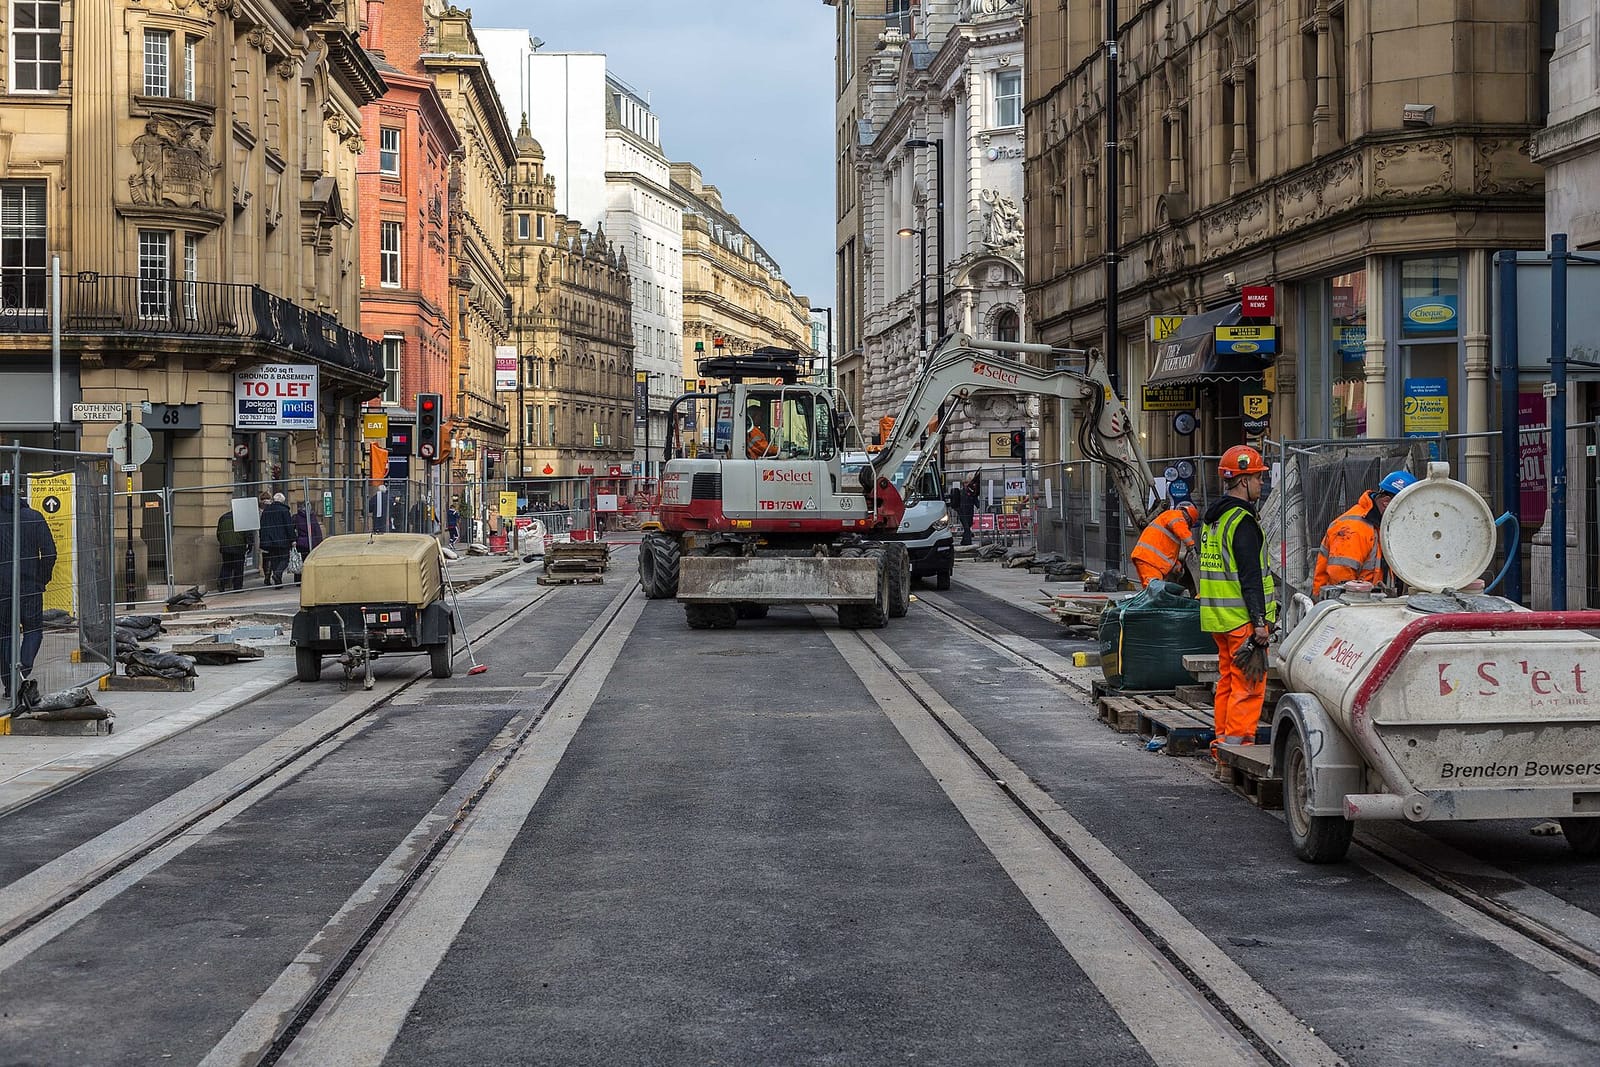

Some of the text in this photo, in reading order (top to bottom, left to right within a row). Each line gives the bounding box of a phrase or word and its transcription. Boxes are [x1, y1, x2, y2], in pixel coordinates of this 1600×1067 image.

[985, 365, 1020, 385] Select
[243, 382, 311, 397] TO LET
[73, 404, 122, 412] SOUTH KING
[245, 400, 276, 409] jackson
[162, 410, 179, 424] 68
[36, 478, 68, 486] Everything
[776, 469, 813, 482] Select
[1006, 481, 1025, 490] MPT
[759, 500, 804, 510] TB175W
[1330, 640, 1364, 670] Select
[1440, 761, 1600, 778] Brendon Bowsers
